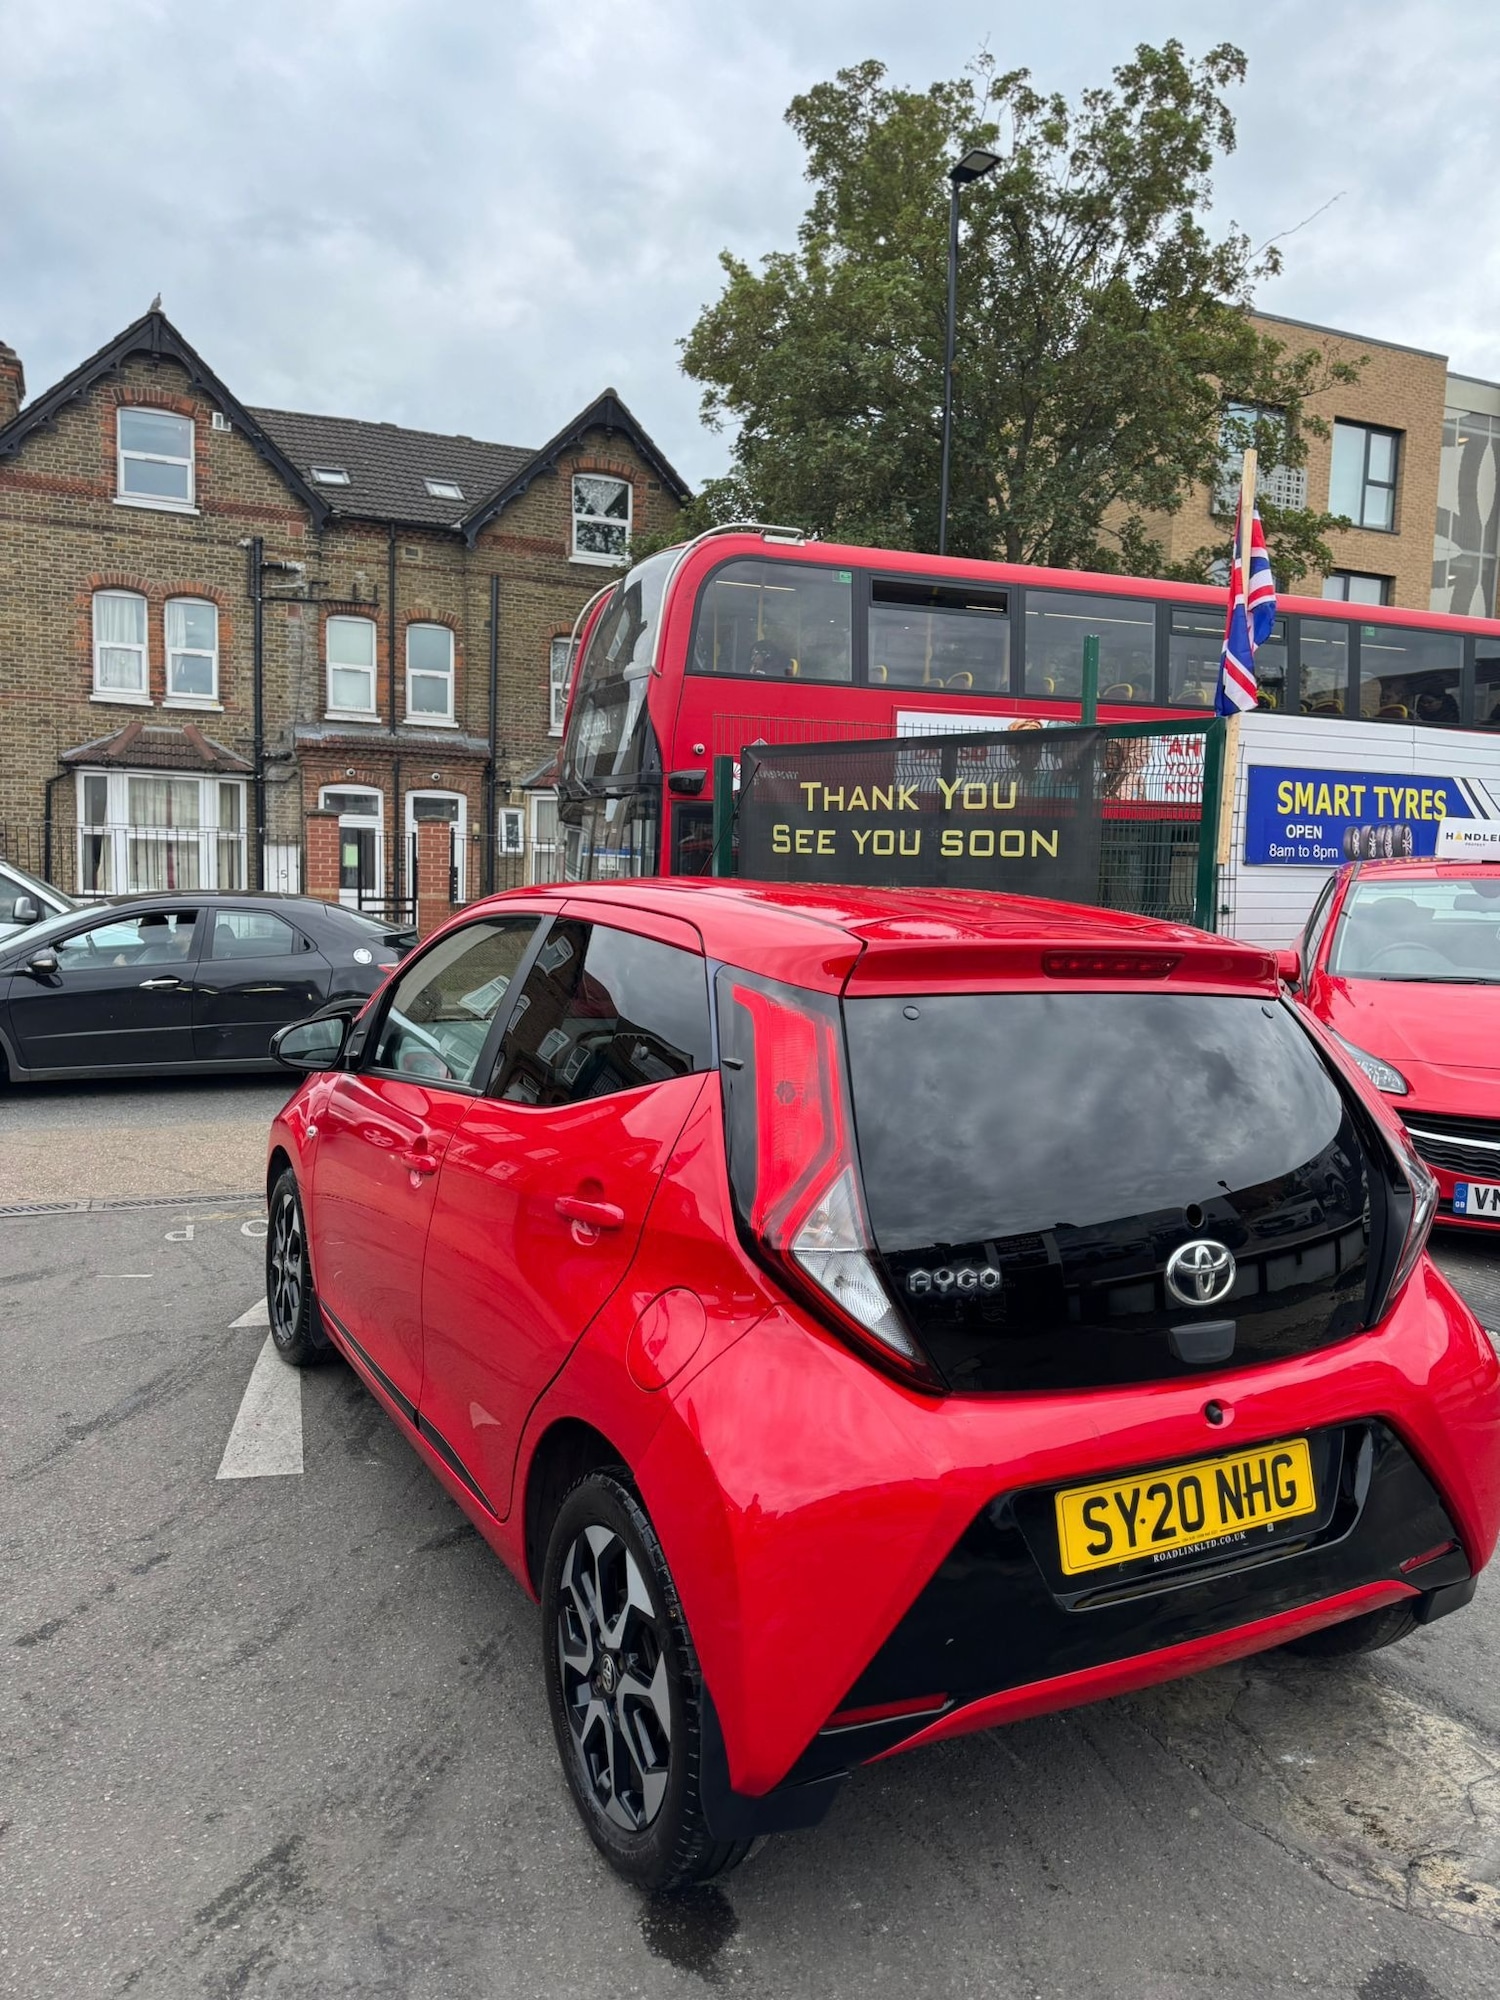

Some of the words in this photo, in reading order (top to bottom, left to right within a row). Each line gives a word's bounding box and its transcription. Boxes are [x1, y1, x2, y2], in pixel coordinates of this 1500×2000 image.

[1165, 782, 1204, 795] KNO
[1276, 780, 1366, 818] SMART
[1374, 787, 1447, 821] TYRES
[1285, 824, 1323, 840] OPEN
[1268, 843, 1293, 857] 8am
[1298, 844, 1310, 857] to
[1312, 845, 1339, 860] 8pm
[910, 1268, 1000, 1293] AYGO
[1082, 1475, 1206, 1556] SY20
[1214, 1453, 1297, 1524] NHG
[1152, 1531, 1247, 1563] ROADLINKLTD.CO.UK
